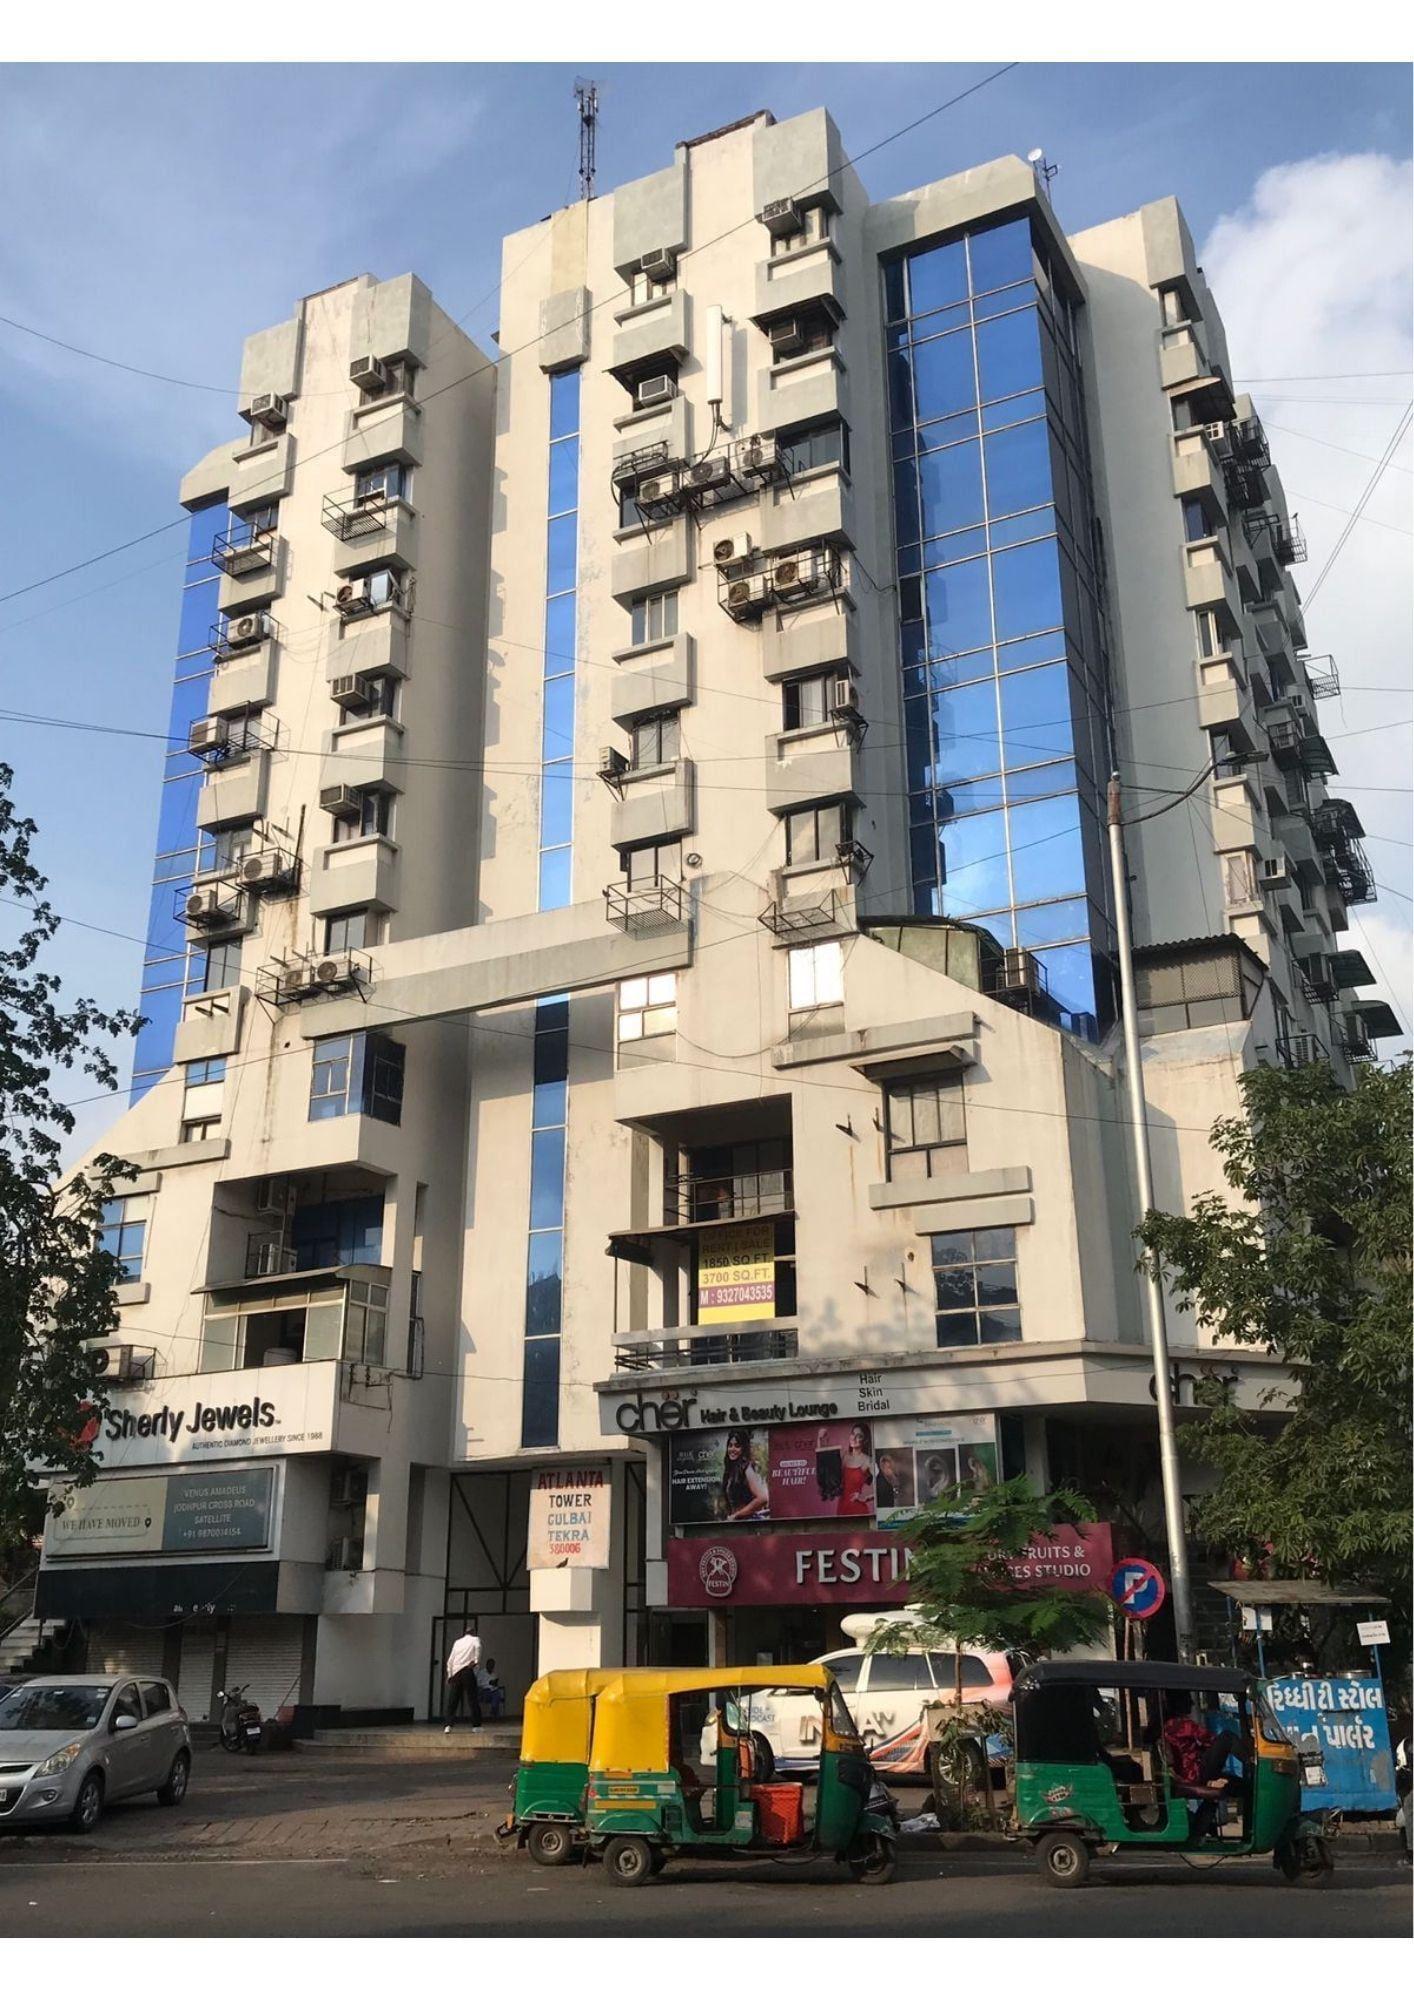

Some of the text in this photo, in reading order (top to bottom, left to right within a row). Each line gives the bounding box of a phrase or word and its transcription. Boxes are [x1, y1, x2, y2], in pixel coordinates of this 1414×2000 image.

[704, 1257, 730, 1270] 1850
[703, 1272, 729, 1285] 3700
[716, 1284, 773, 1304] 9327043535
[859, 1372, 881, 1385] Hair
[859, 1387, 883, 1398] Skin
[857, 1399, 890, 1412] Bridal
[700, 1402, 838, 1424] Hair & Beauty Lounge
[105, 1397, 276, 1443] Sherly Jewels
[192, 1439, 223, 1450] AUTHENTIC
[224, 1437, 251, 1447] DIAMOND
[252, 1435, 286, 1446] JEWELLERY
[287, 1433, 305, 1442] SINCE
[537, 1470, 604, 1490] ATLANTA
[687, 1475, 721, 1484] EXTENSION
[184, 1487, 209, 1498] VENUS
[686, 1483, 708, 1491] AWAY!
[208, 1500, 233, 1510] CROSS
[233, 1498, 256, 1509] ROAD
[549, 1493, 592, 1508] TOWER
[62, 1517, 140, 1530] WE HAVE MOVED
[194, 1513, 232, 1525] SATELLITE
[548, 1530, 590, 1542] TEKRA
[549, 1543, 582, 1555] 380006
[1073, 1545, 1085, 1558] &
